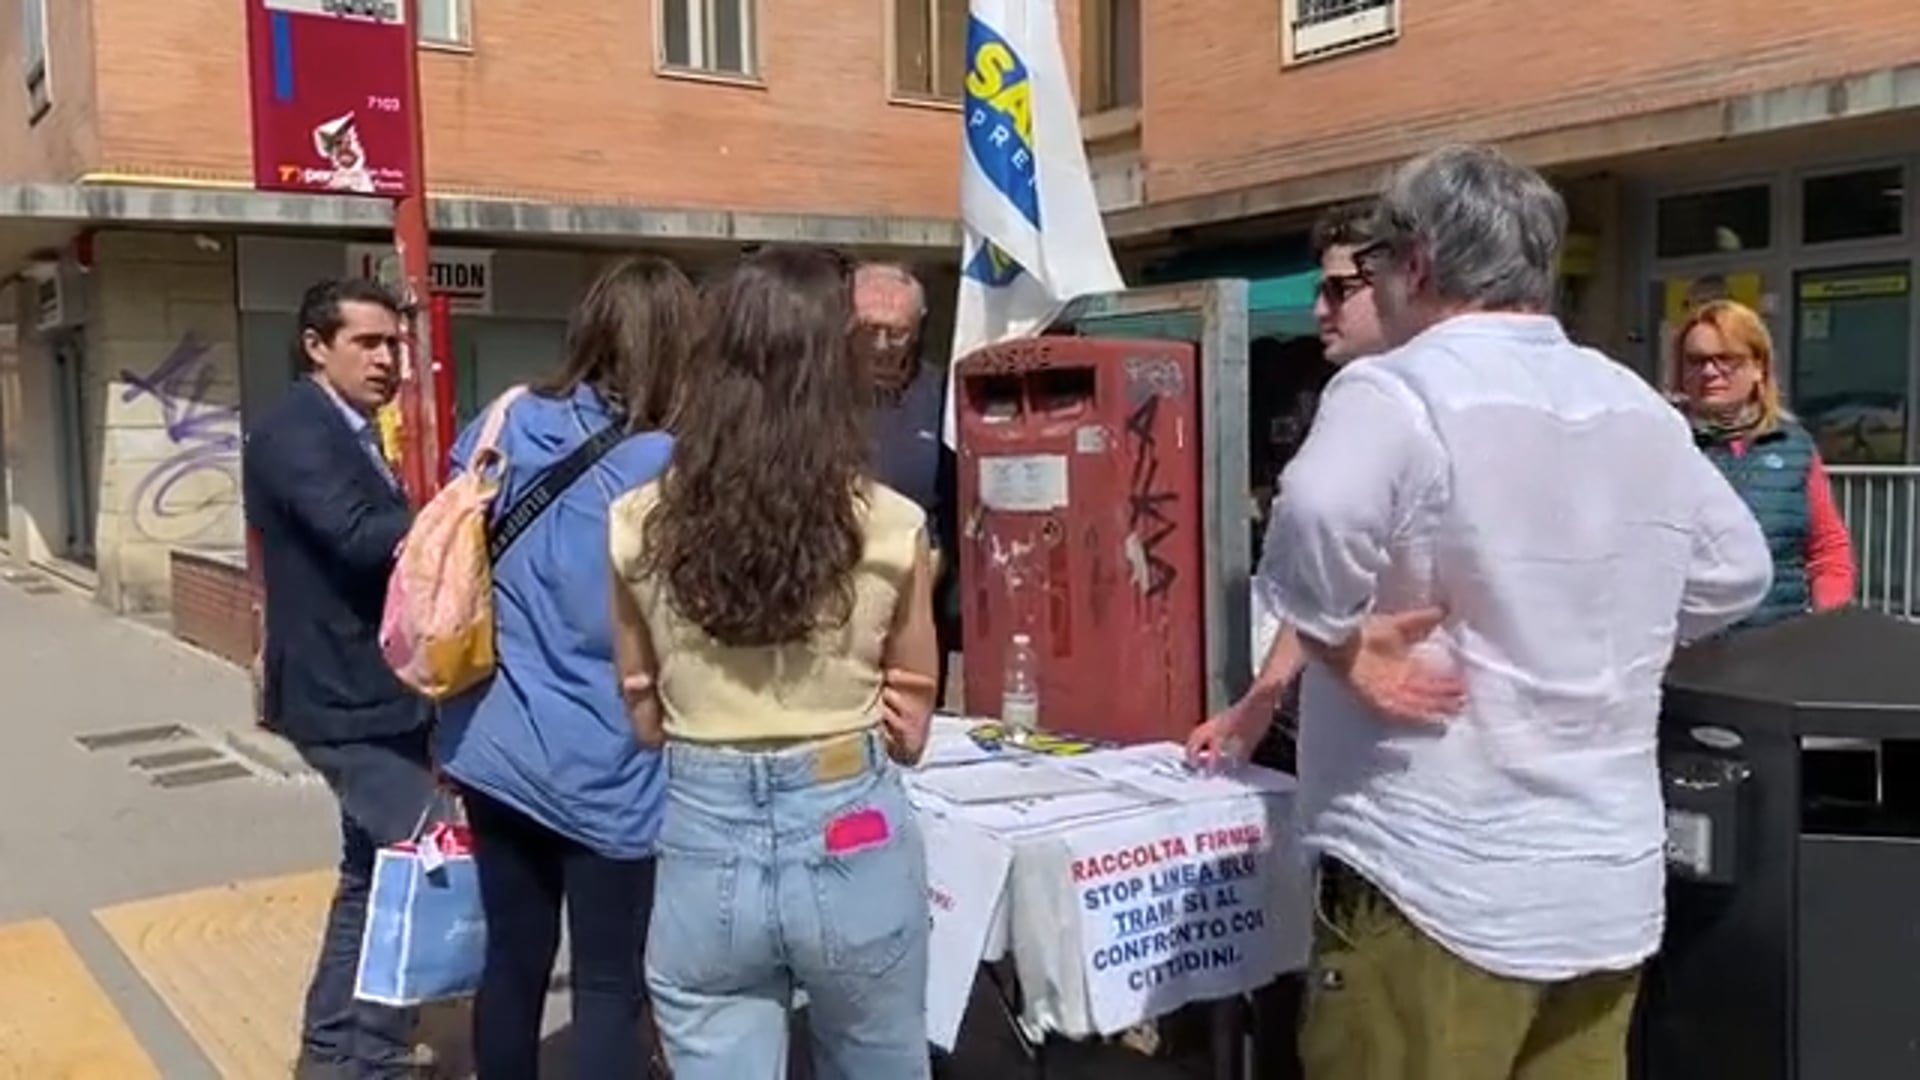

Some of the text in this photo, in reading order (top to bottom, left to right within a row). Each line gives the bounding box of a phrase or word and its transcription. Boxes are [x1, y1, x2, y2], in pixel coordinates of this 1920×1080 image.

[969, 110, 1036, 187] PRE
[1070, 838, 1187, 882] RACCOLTA
[1084, 877, 1144, 909] STOP
[1150, 862, 1213, 893] LINEA
[1216, 885, 1240, 907] AL
